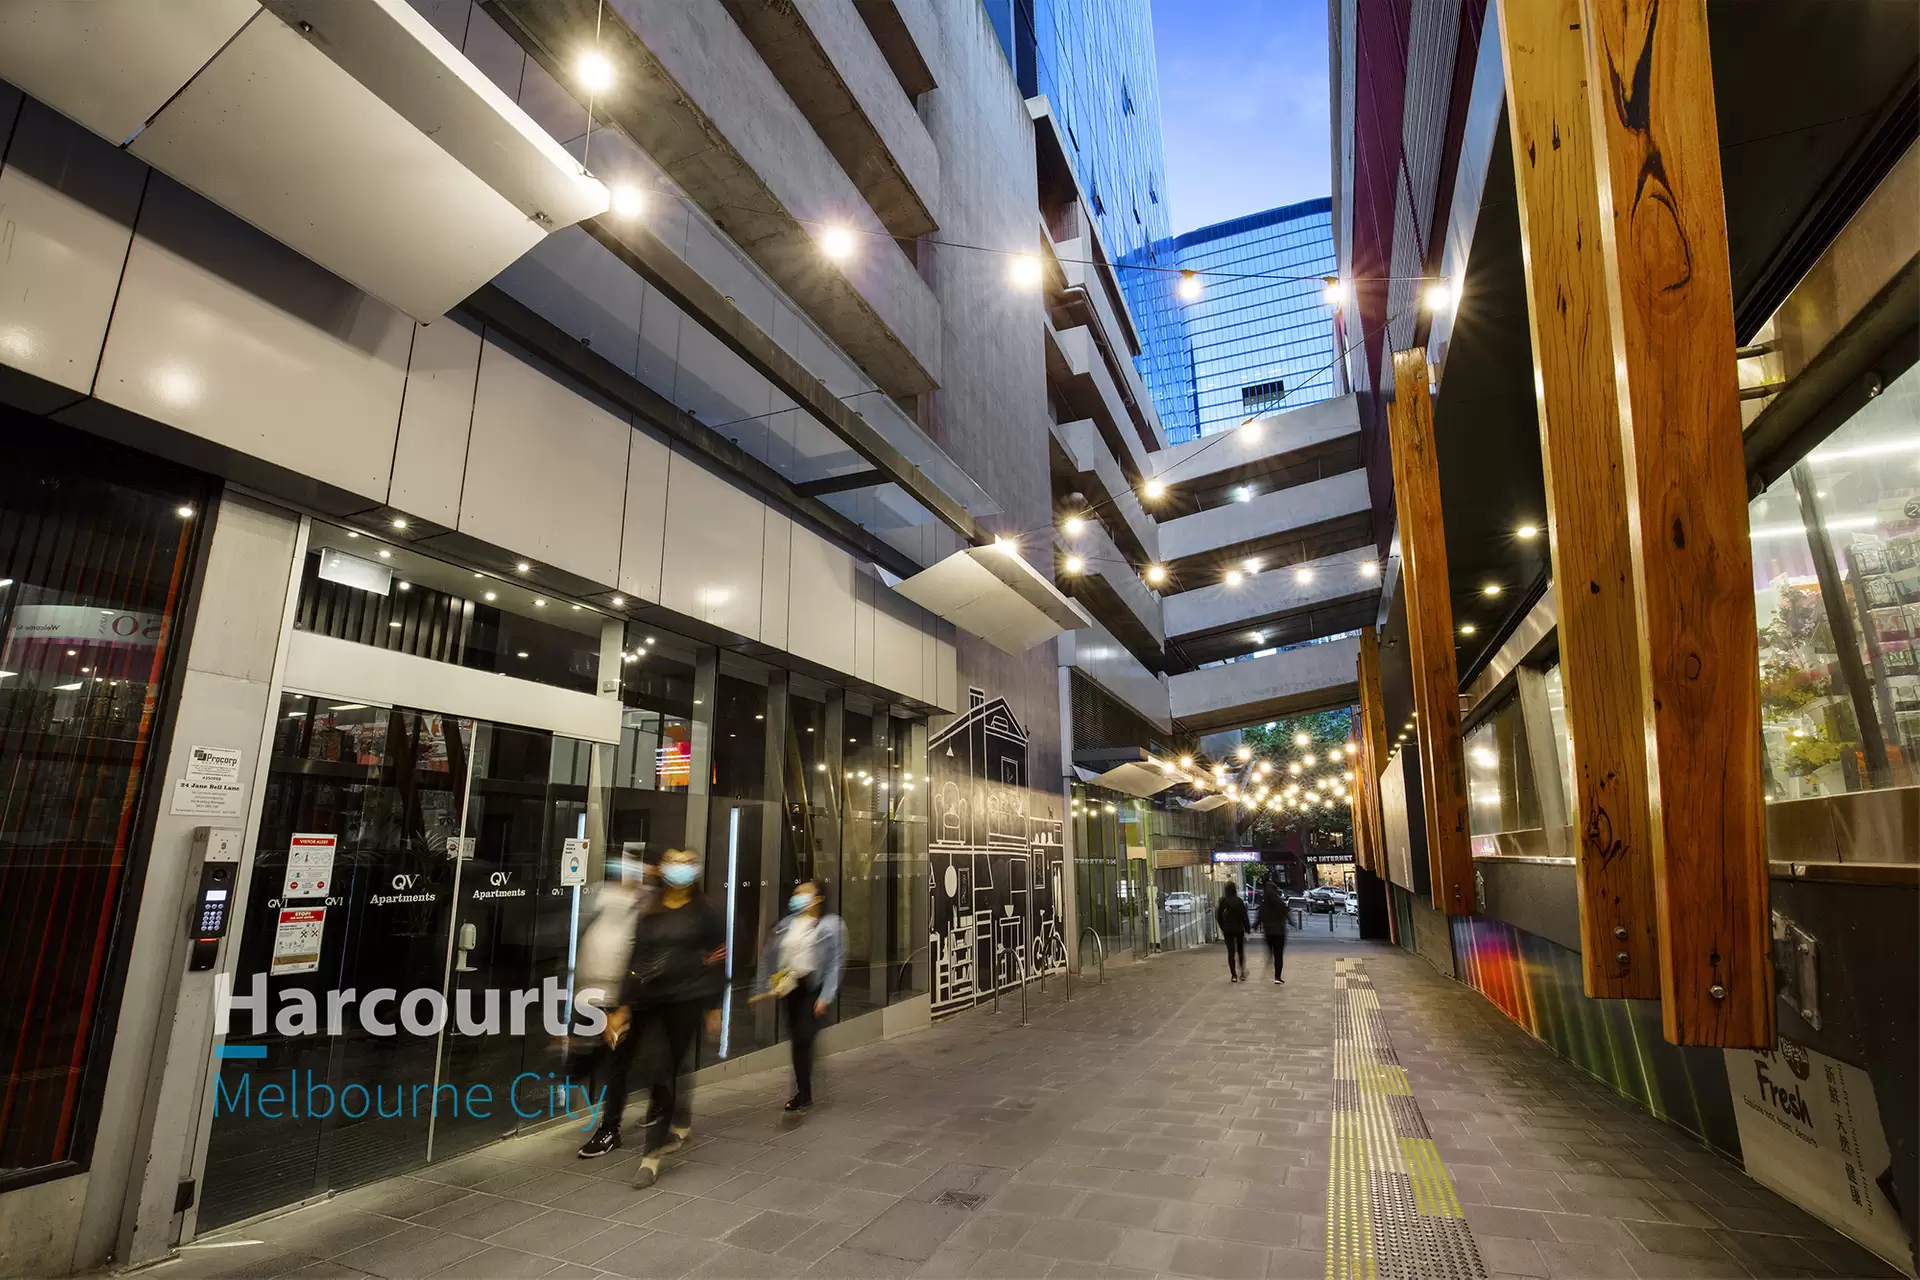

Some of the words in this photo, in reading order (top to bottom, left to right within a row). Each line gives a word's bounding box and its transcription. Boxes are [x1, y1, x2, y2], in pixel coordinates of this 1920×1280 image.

[206, 753, 238, 767] Procorp
[1318, 854, 1353, 862] INTERNET
[392, 873, 420, 891] QV
[489, 871, 513, 887] QV
[370, 892, 436, 906] Apartments
[472, 888, 526, 900] Apartments
[1754, 1059, 1814, 1129] Fresh
